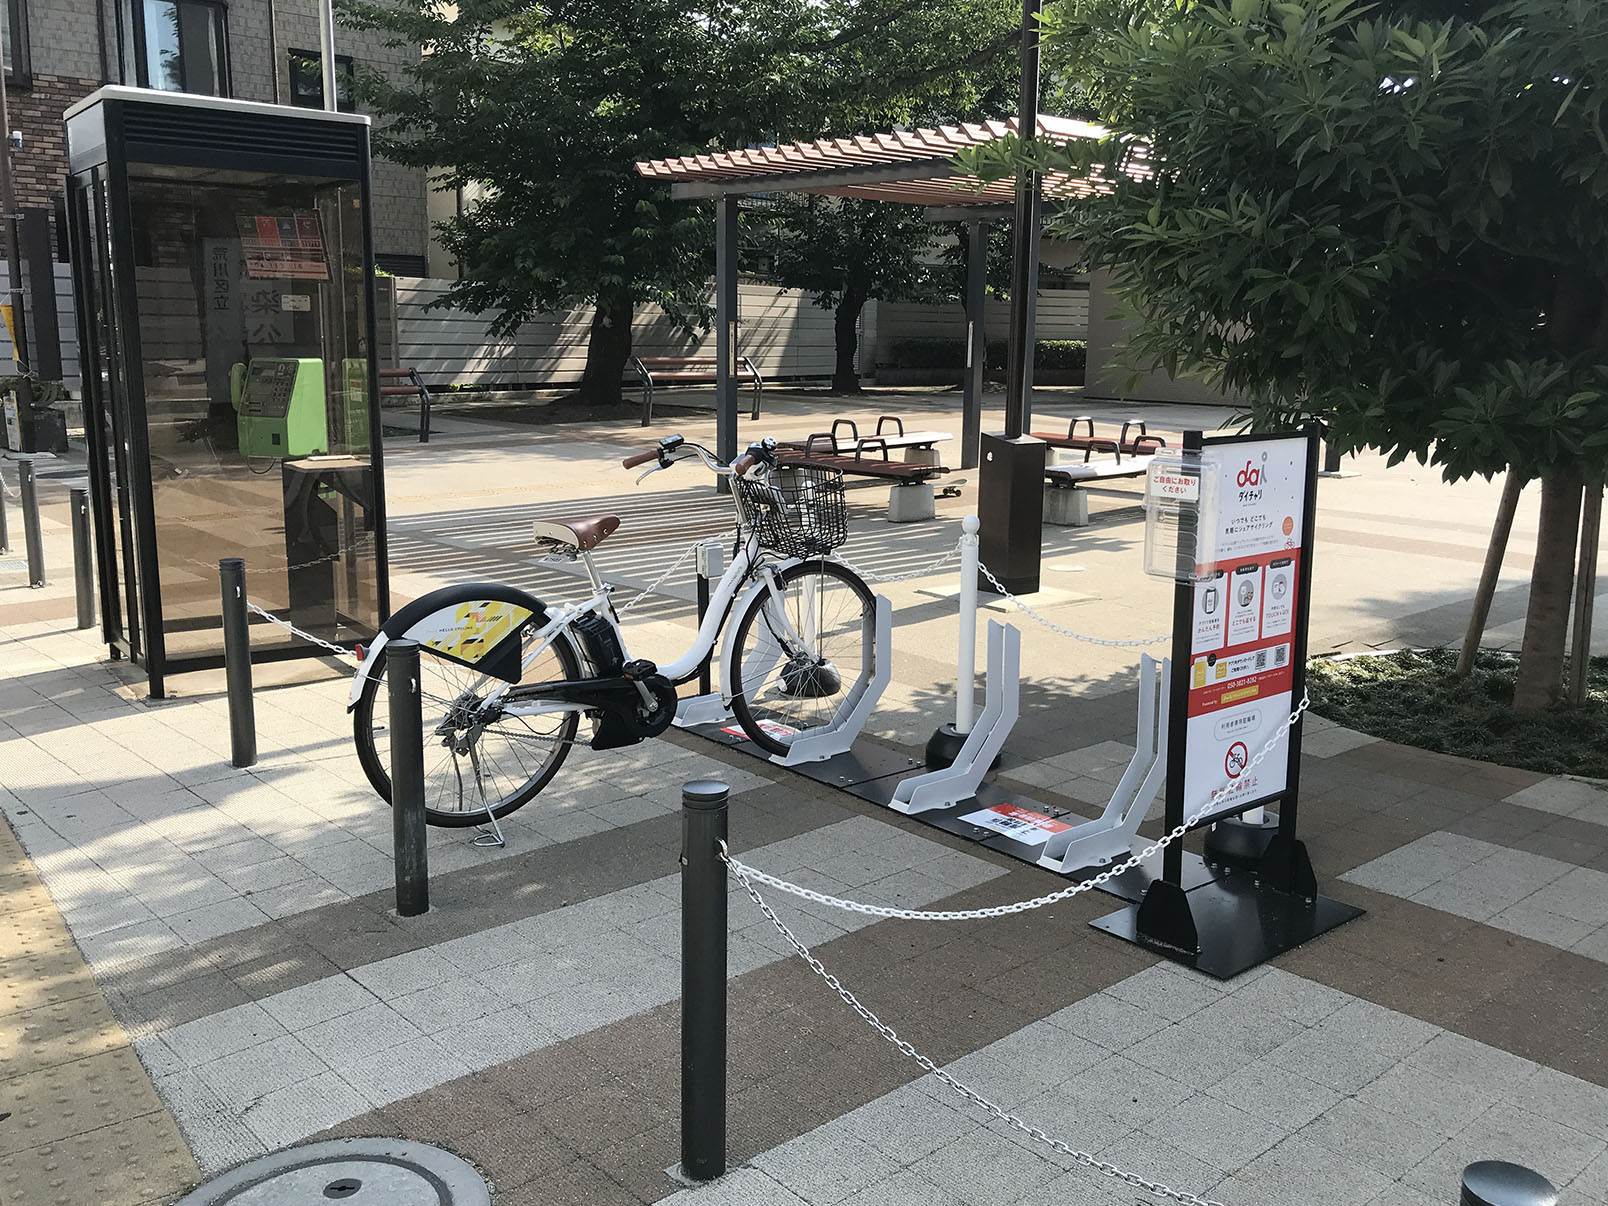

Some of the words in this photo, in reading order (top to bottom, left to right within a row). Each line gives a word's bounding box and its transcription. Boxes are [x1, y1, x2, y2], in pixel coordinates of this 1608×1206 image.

[1153, 475, 1197, 487] ご自由にお取り
[1162, 485, 1187, 494] ください
[1238, 489, 1263, 503] ダイチャリ
